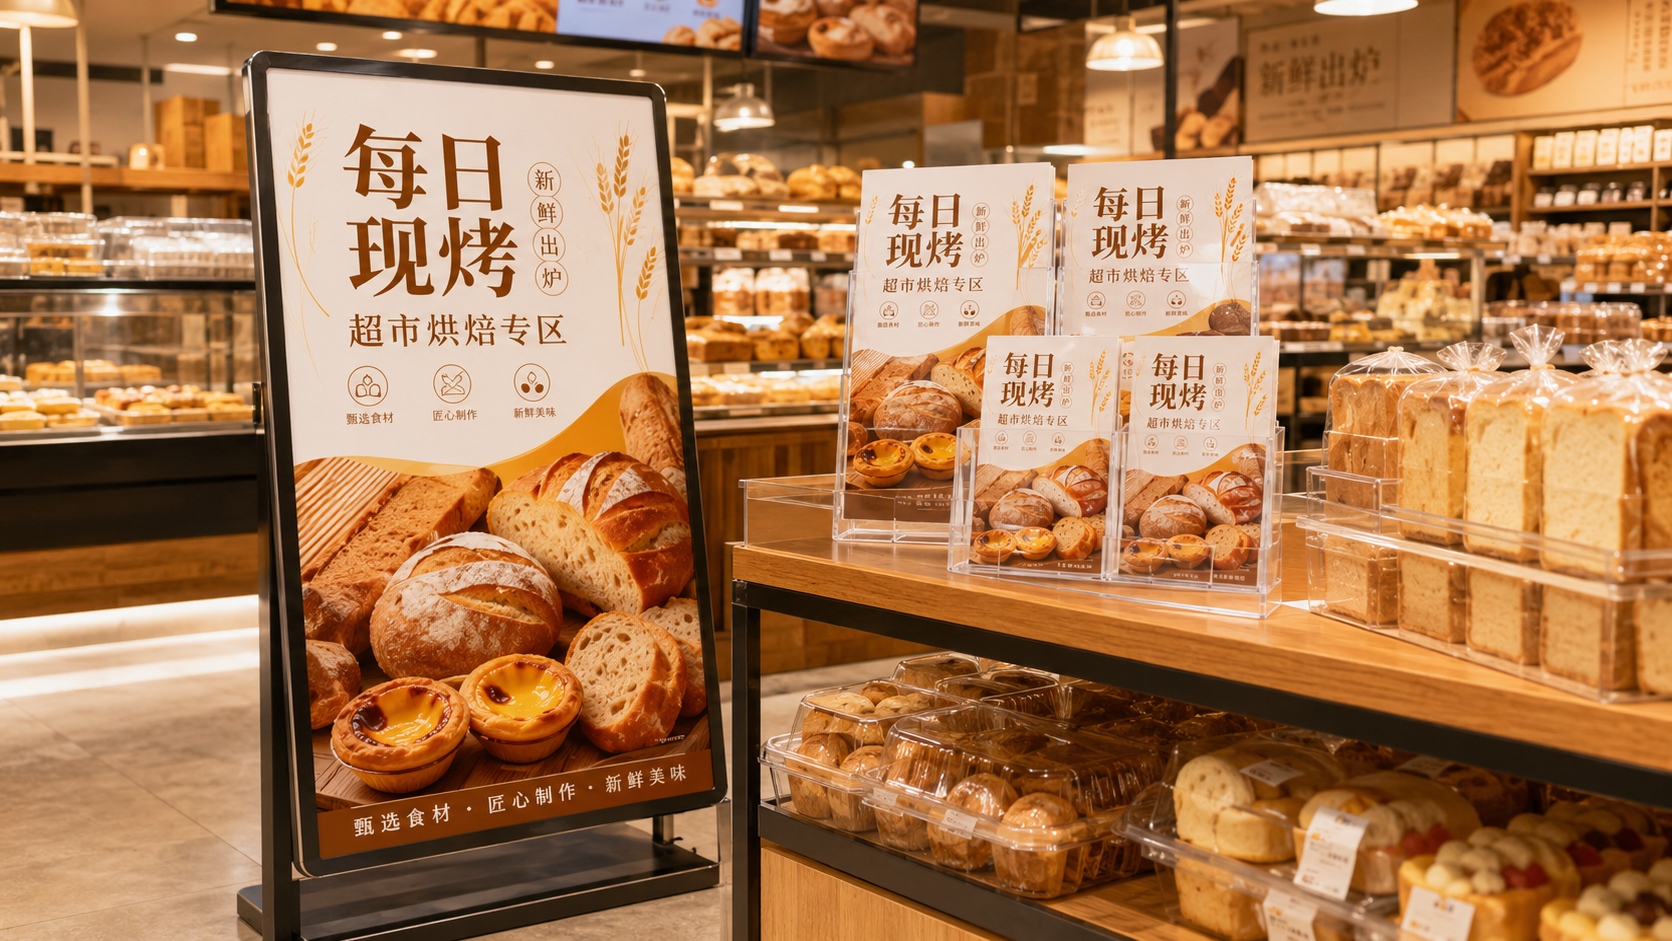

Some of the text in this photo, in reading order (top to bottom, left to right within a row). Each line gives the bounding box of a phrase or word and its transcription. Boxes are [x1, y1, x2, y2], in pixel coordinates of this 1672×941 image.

[343, 124, 502, 211] 每日
[888, 193, 961, 231] 每日
[1093, 185, 1165, 223] 每日
[533, 167, 563, 290] 新鲜出炉
[1091, 223, 1169, 260] 现烤
[346, 215, 518, 298] 现烤
[886, 231, 964, 270] 现烤
[882, 276, 984, 294] 超市烘焙专区
[1088, 267, 1190, 285] 超市烘焙专区
[348, 313, 567, 348] 超市烘焙专区
[1003, 352, 1054, 379] 每日
[1151, 353, 1205, 381] 每日
[1000, 380, 1055, 408] 现烤
[1149, 382, 1207, 412] 现烤
[346, 411, 394, 427] 甄选食材
[432, 408, 478, 422] 匠心制作
[513, 406, 557, 419] 新鲜美味
